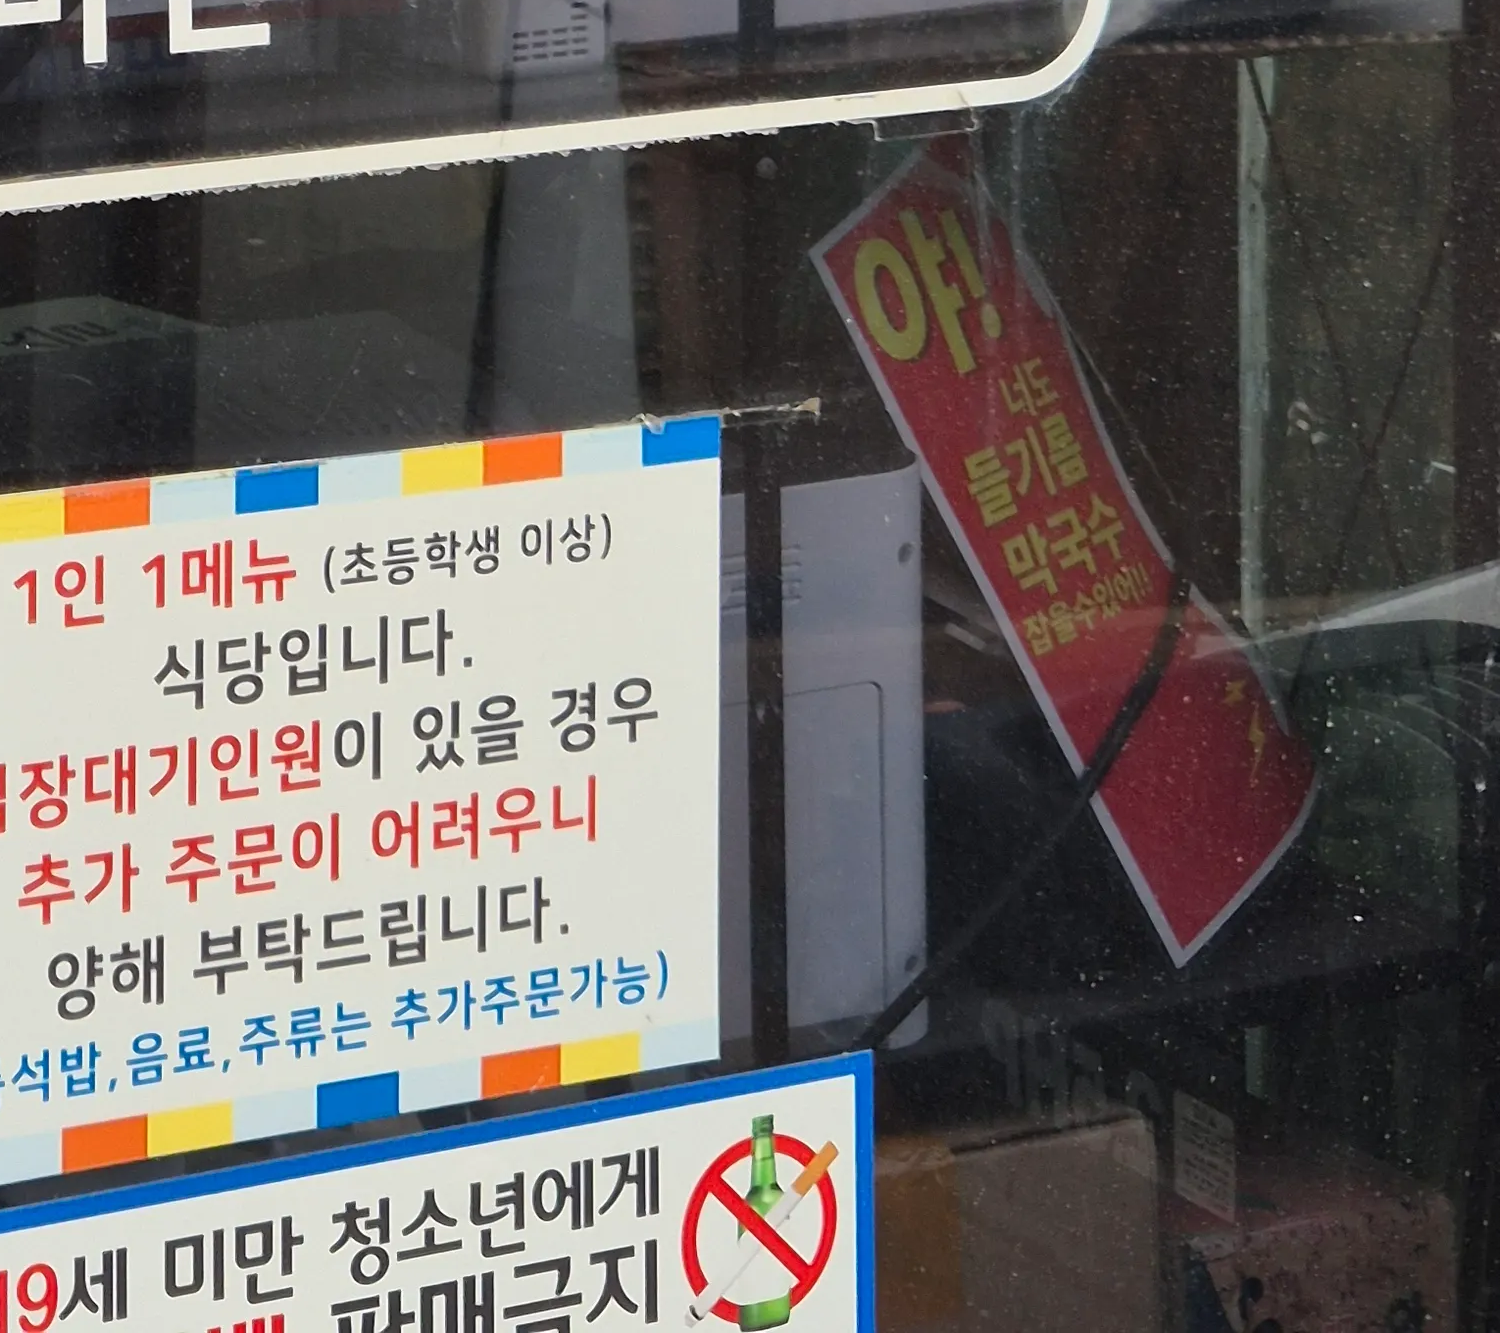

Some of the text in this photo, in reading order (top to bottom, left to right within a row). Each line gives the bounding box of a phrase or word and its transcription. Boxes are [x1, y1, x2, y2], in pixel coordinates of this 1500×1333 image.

[853, 208, 1002, 375] 야!
[999, 358, 1059, 416] 너도
[964, 413, 1088, 527] 들기름
[14, 513, 612, 626] 1인 1메뉴 (초등학생 이상)
[1002, 492, 1124, 595] 막국수
[154, 610, 475, 710] 식당입니다.
[413, 696, 525, 768] 있을
[551, 676, 660, 751] 경우
[18, 775, 600, 927] 추가 주문이 어려우니
[48, 875, 572, 1021] 양해 부탁드립니다.
[391, 947, 669, 1042] 추가주문가능)
[164, 1214, 304, 1304] 미만
[330, 1147, 661, 1285] 청소년에게
